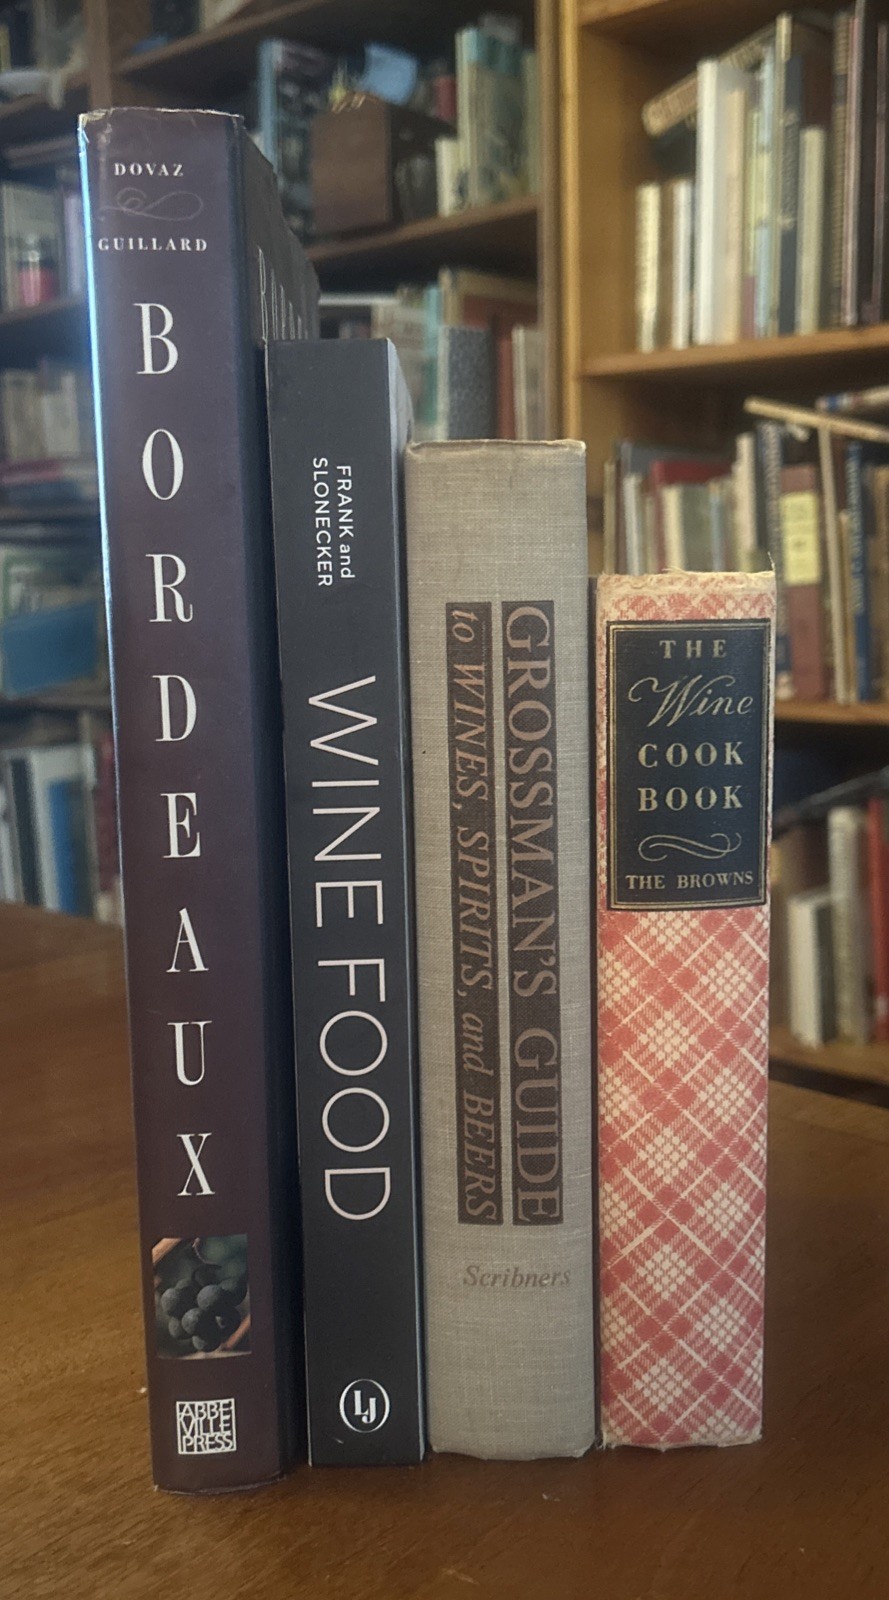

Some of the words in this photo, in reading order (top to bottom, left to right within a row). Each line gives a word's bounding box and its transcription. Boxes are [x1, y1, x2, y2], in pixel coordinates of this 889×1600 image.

[114, 162, 184, 176] DOVAZ
[98, 237, 208, 251] GUILLARD
[313, 457, 333, 586] SLONECKER
[336, 466, 355, 538] FRANK
[339, 544, 356, 578] and
[452, 609, 480, 644] to
[659, 639, 727, 659] THE
[628, 674, 754, 728] Wine
[132, 303, 215, 1196] BORDEAUX
[452, 663, 490, 811] WINES,
[637, 742, 744, 768] COOK
[308, 675, 384, 928] WINE
[506, 606, 558, 998] GROSSMAN'S
[638, 785, 743, 812] BOOK
[625, 875, 666, 891] THE
[677, 871, 755, 890] BROWNS
[457, 826, 494, 998] SPIRITS,
[462, 1012, 495, 1077] and
[317, 958, 391, 1221] FOOD
[514, 1028, 561, 1223] GUIDE
[463, 1089, 498, 1222] BEERS
[462, 1264, 571, 1289] Scribners
[182, 1433, 233, 1453] PRESS
